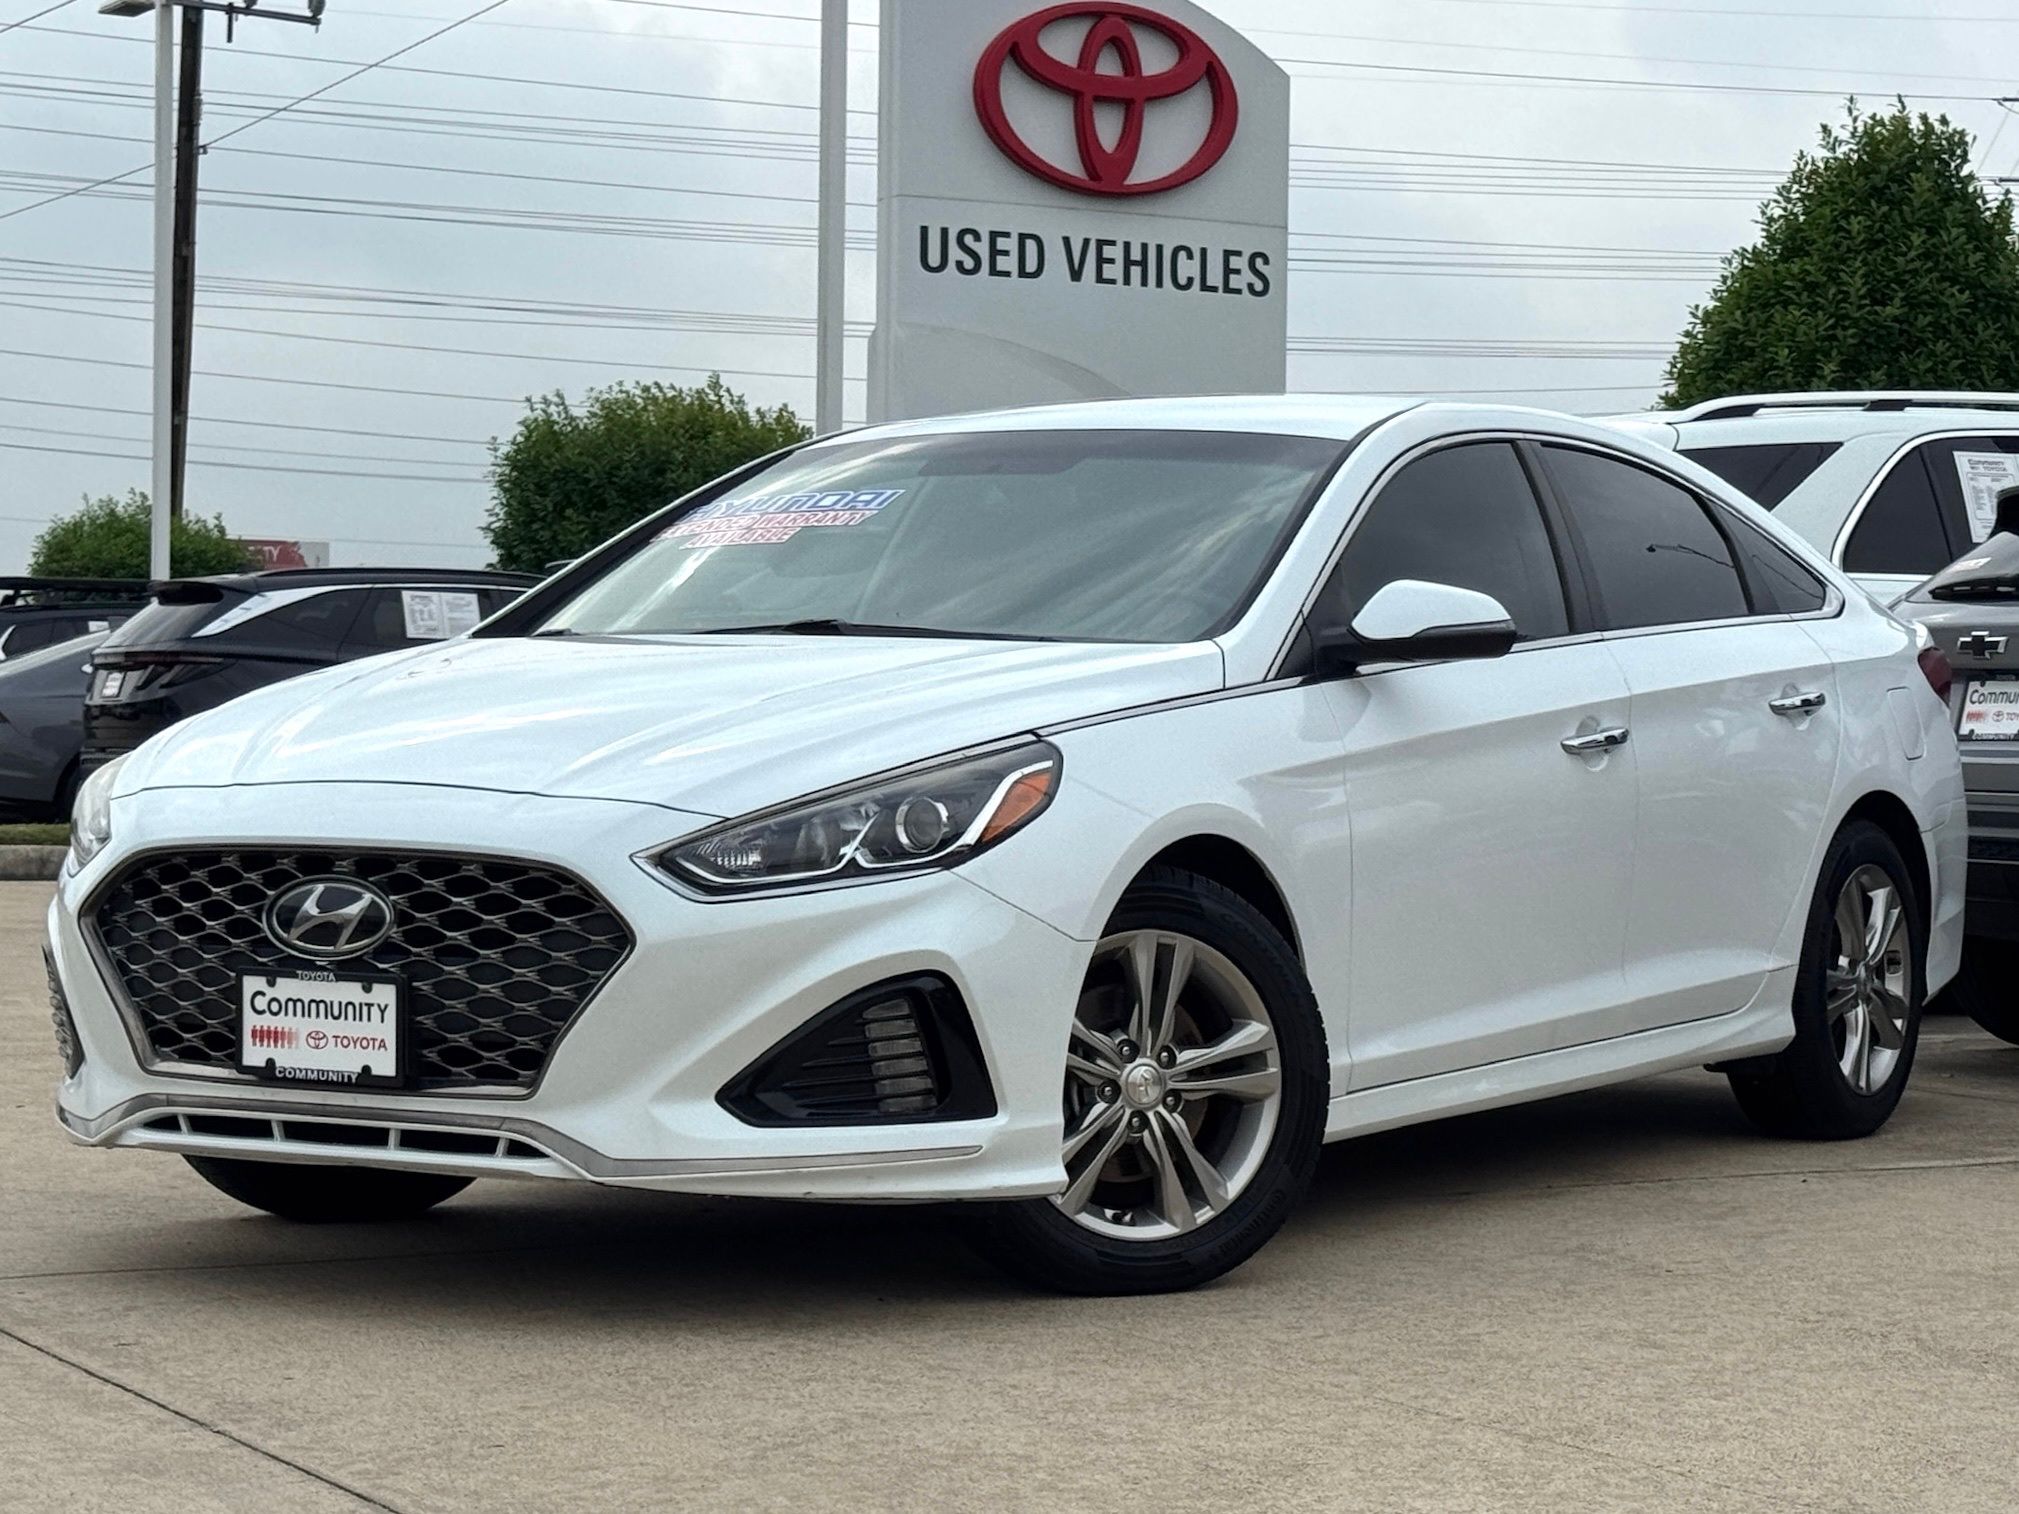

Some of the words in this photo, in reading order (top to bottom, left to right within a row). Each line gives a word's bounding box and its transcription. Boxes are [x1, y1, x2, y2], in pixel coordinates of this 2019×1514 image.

[919, 225, 1045, 279] USED
[1062, 236, 1271, 298] VEHICLES
[674, 490, 905, 524] HYUNDAI
[754, 510, 877, 528] WARRANTY
[684, 528, 798, 547] AVAILABLE
[296, 970, 337, 982] TOYOTA
[332, 1035, 388, 1051] TOYOTA
[275, 1066, 358, 1083] COMMUNITY
